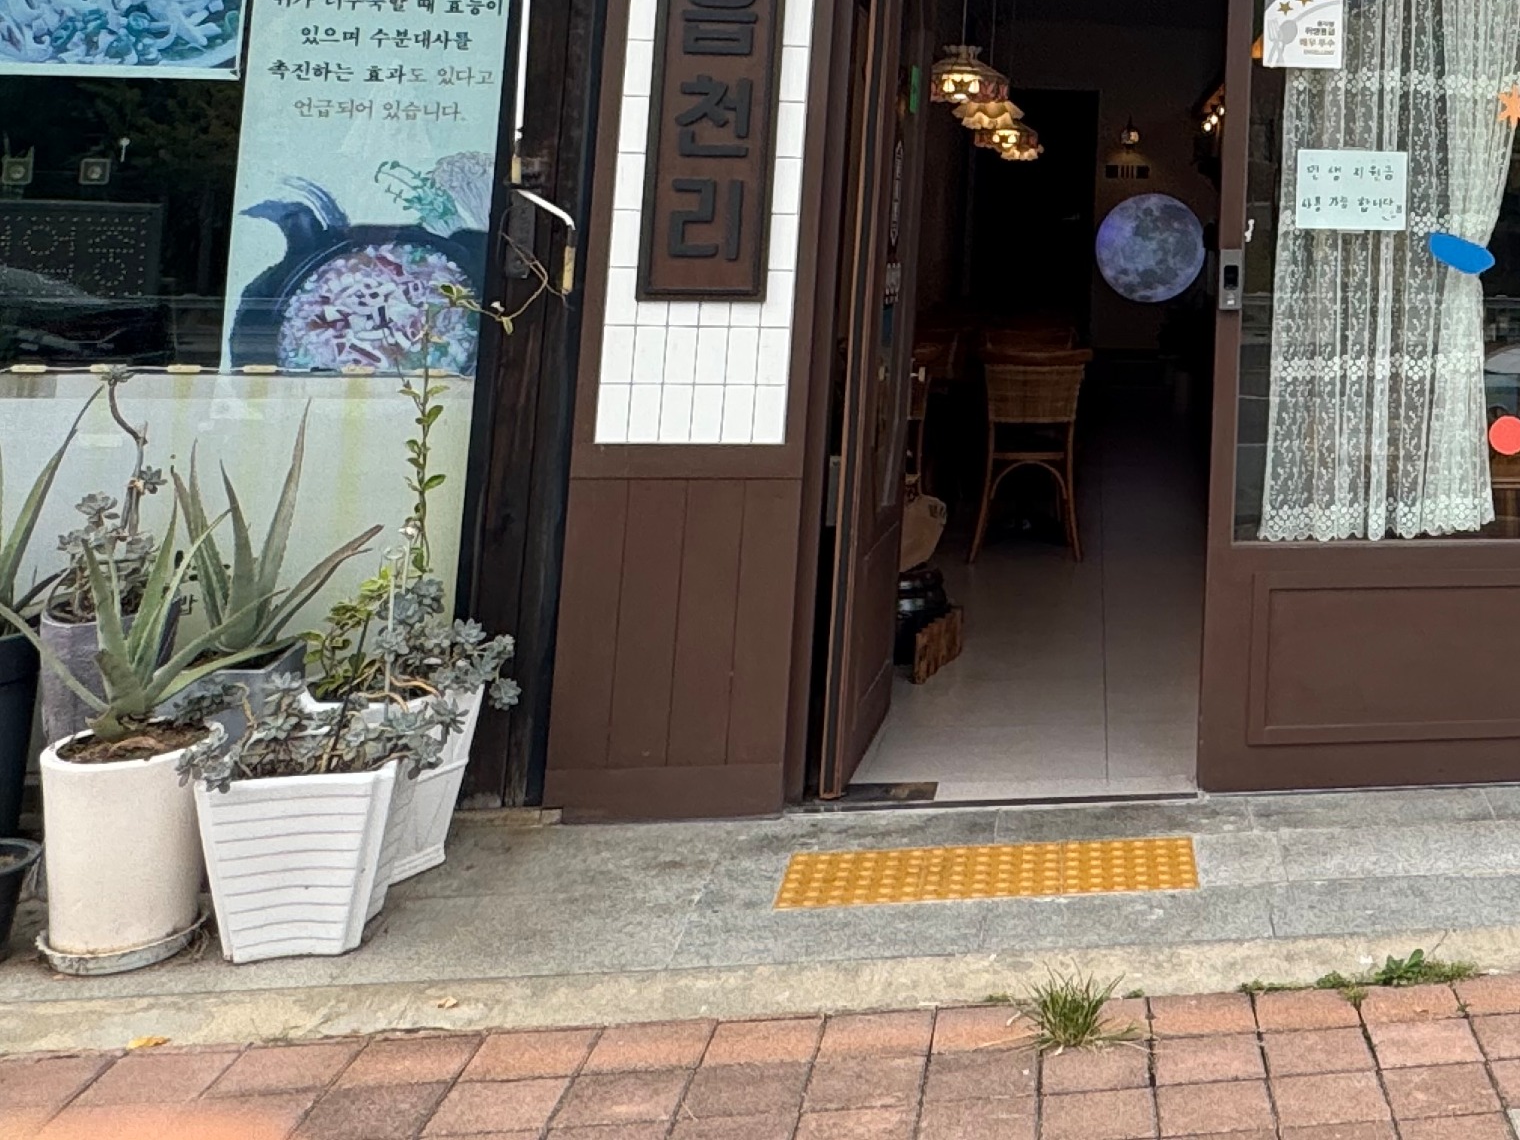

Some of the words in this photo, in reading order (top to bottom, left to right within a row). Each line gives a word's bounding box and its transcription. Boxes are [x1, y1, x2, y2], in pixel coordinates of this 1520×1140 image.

[301, 24, 361, 47] 있으며
[369, 28, 473, 51] 수분대사를
[267, 59, 354, 82] 촉진하는
[363, 64, 428, 84] 효과도
[437, 66, 495, 87] 있다고
[294, 97, 374, 120] 언급되어
